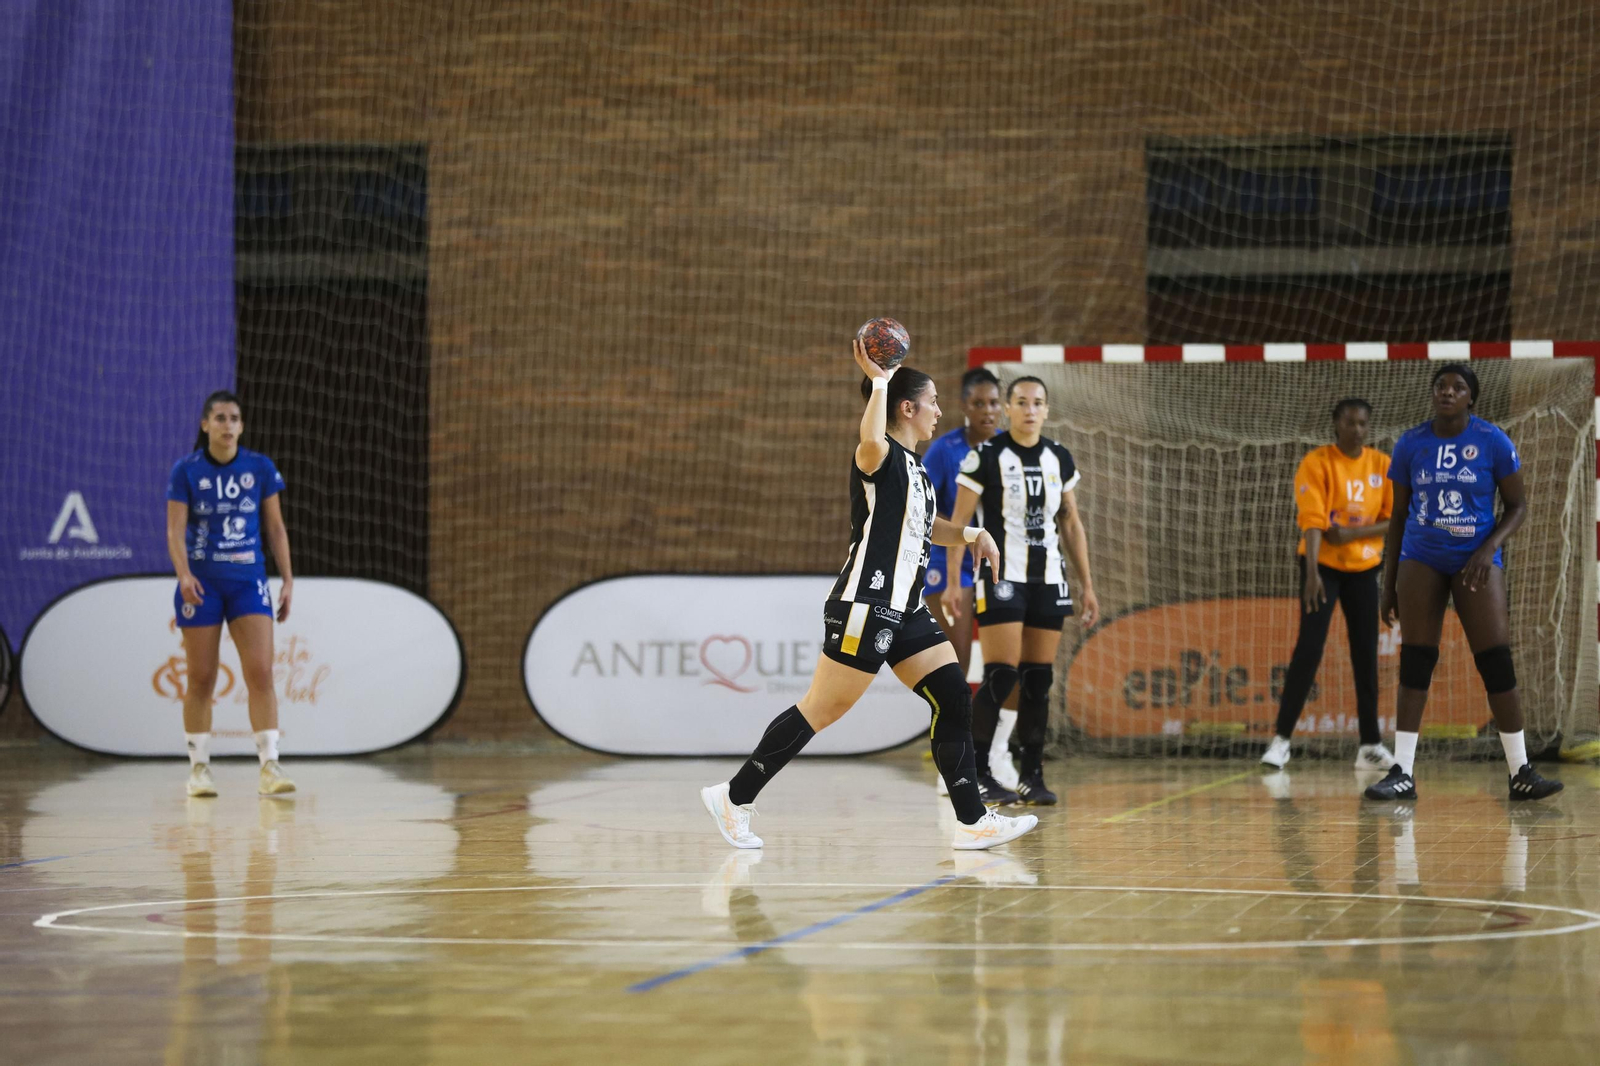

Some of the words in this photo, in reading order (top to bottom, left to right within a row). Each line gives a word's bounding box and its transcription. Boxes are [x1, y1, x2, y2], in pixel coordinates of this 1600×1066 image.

[1436, 444, 1457, 469] 15
[216, 475, 241, 499] 16
[1025, 475, 1043, 497] 17
[1346, 479, 1365, 502] 12
